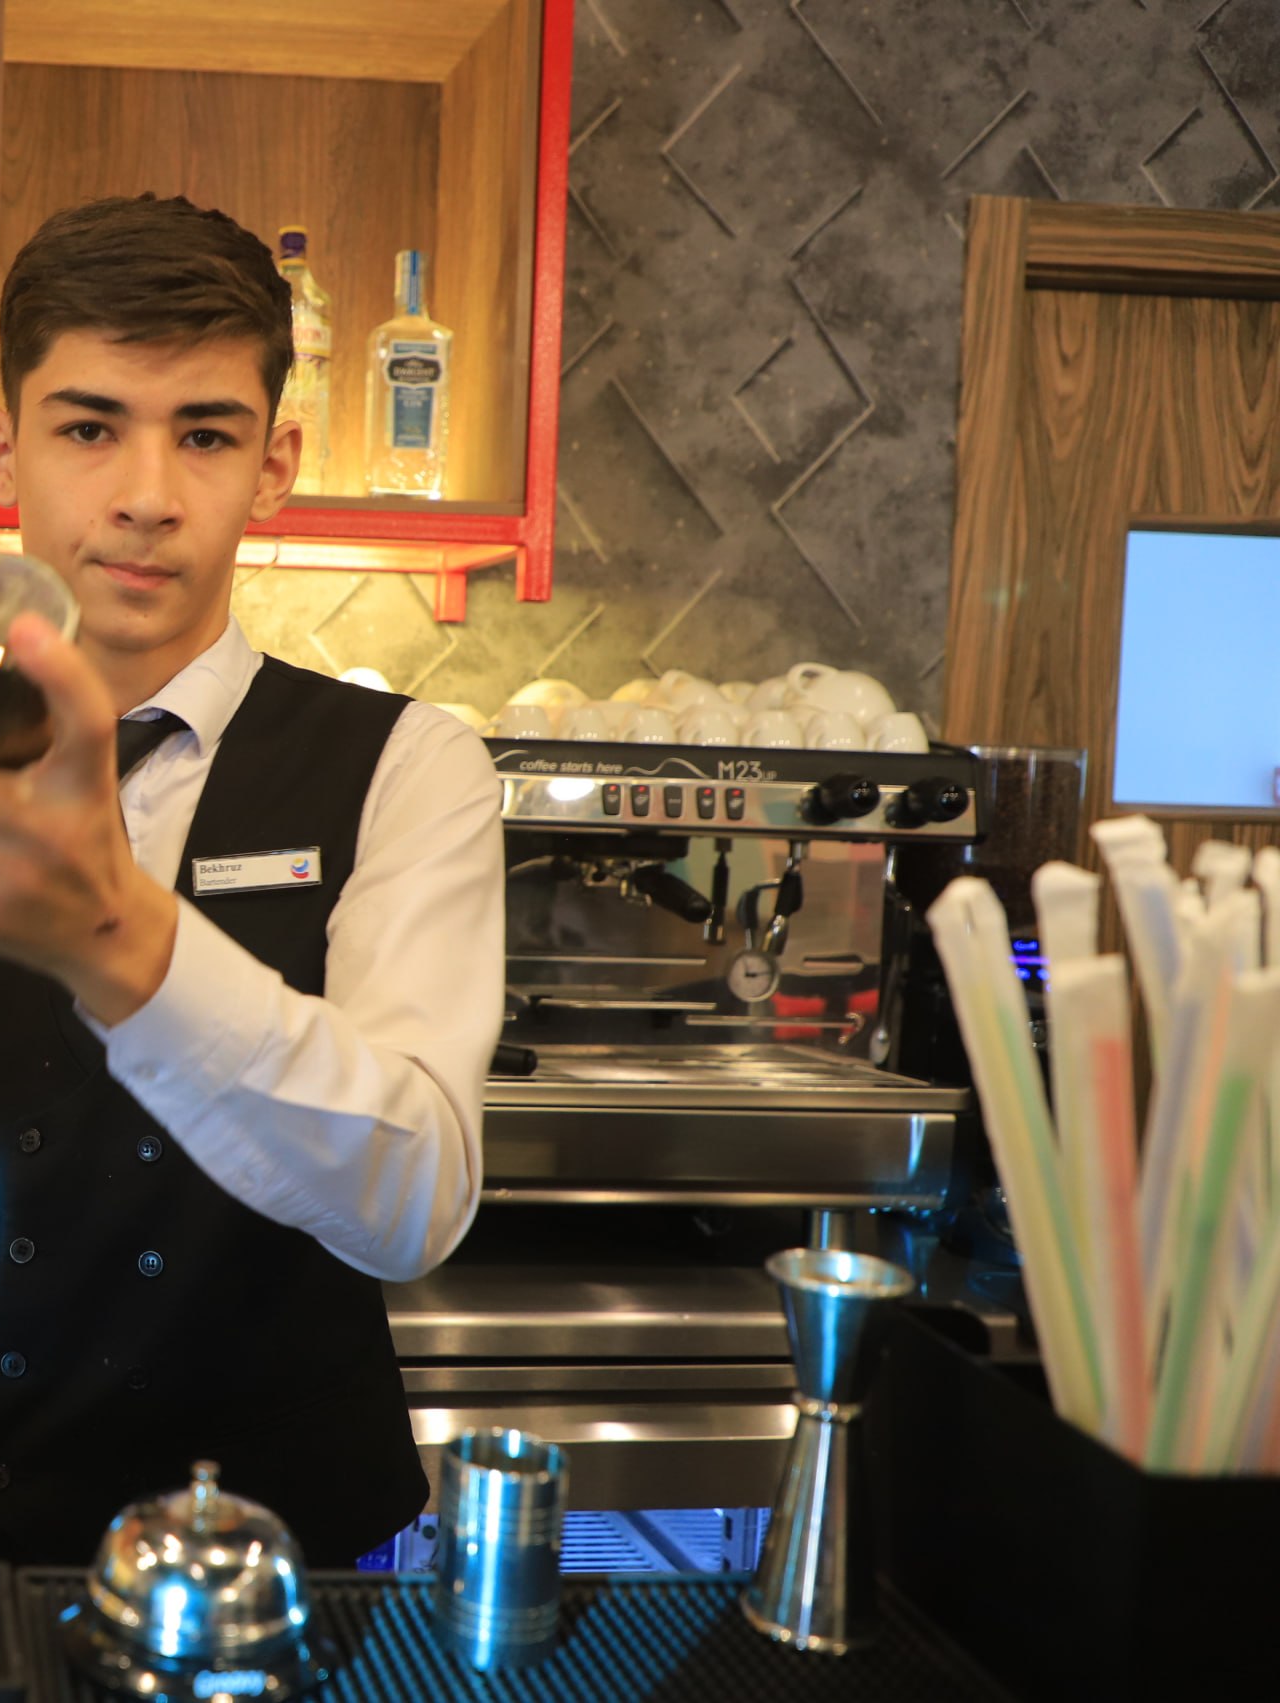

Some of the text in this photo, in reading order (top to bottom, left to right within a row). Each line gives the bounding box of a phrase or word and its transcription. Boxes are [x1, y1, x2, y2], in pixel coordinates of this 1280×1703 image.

[519, 758, 623, 775] coffee starts here
[717, 759, 761, 781] M23
[200, 863, 242, 874] Bekhruz
